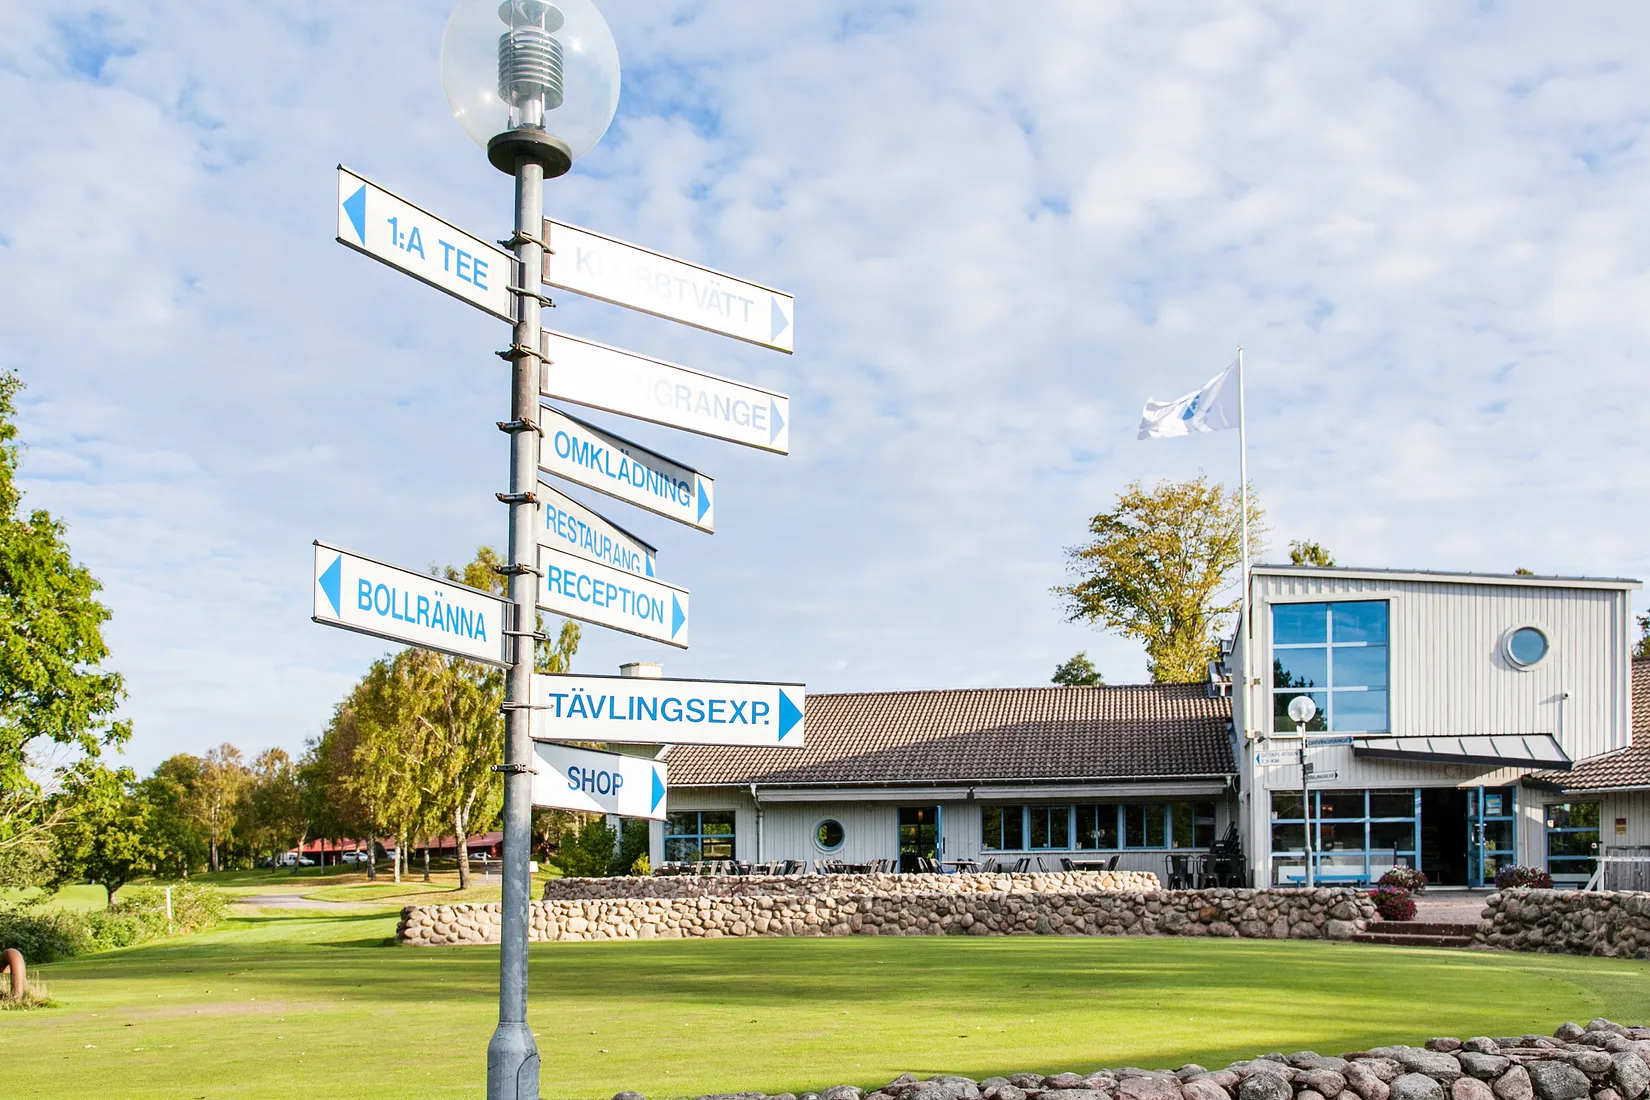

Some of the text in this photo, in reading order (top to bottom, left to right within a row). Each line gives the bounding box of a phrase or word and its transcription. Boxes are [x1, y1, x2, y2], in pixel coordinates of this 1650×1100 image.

[387, 217, 489, 291] 1:A TEE
[575, 246, 755, 322] KBBTVÄTT
[553, 431, 691, 508] OMKLÄDNING
[545, 503, 640, 573] RESTAURANG
[357, 578, 487, 643] BOLLRÄNNA
[547, 564, 664, 625] RECEPTION
[548, 687, 770, 725] TÄVLINGSEXP.
[567, 766, 624, 795] SHOP
